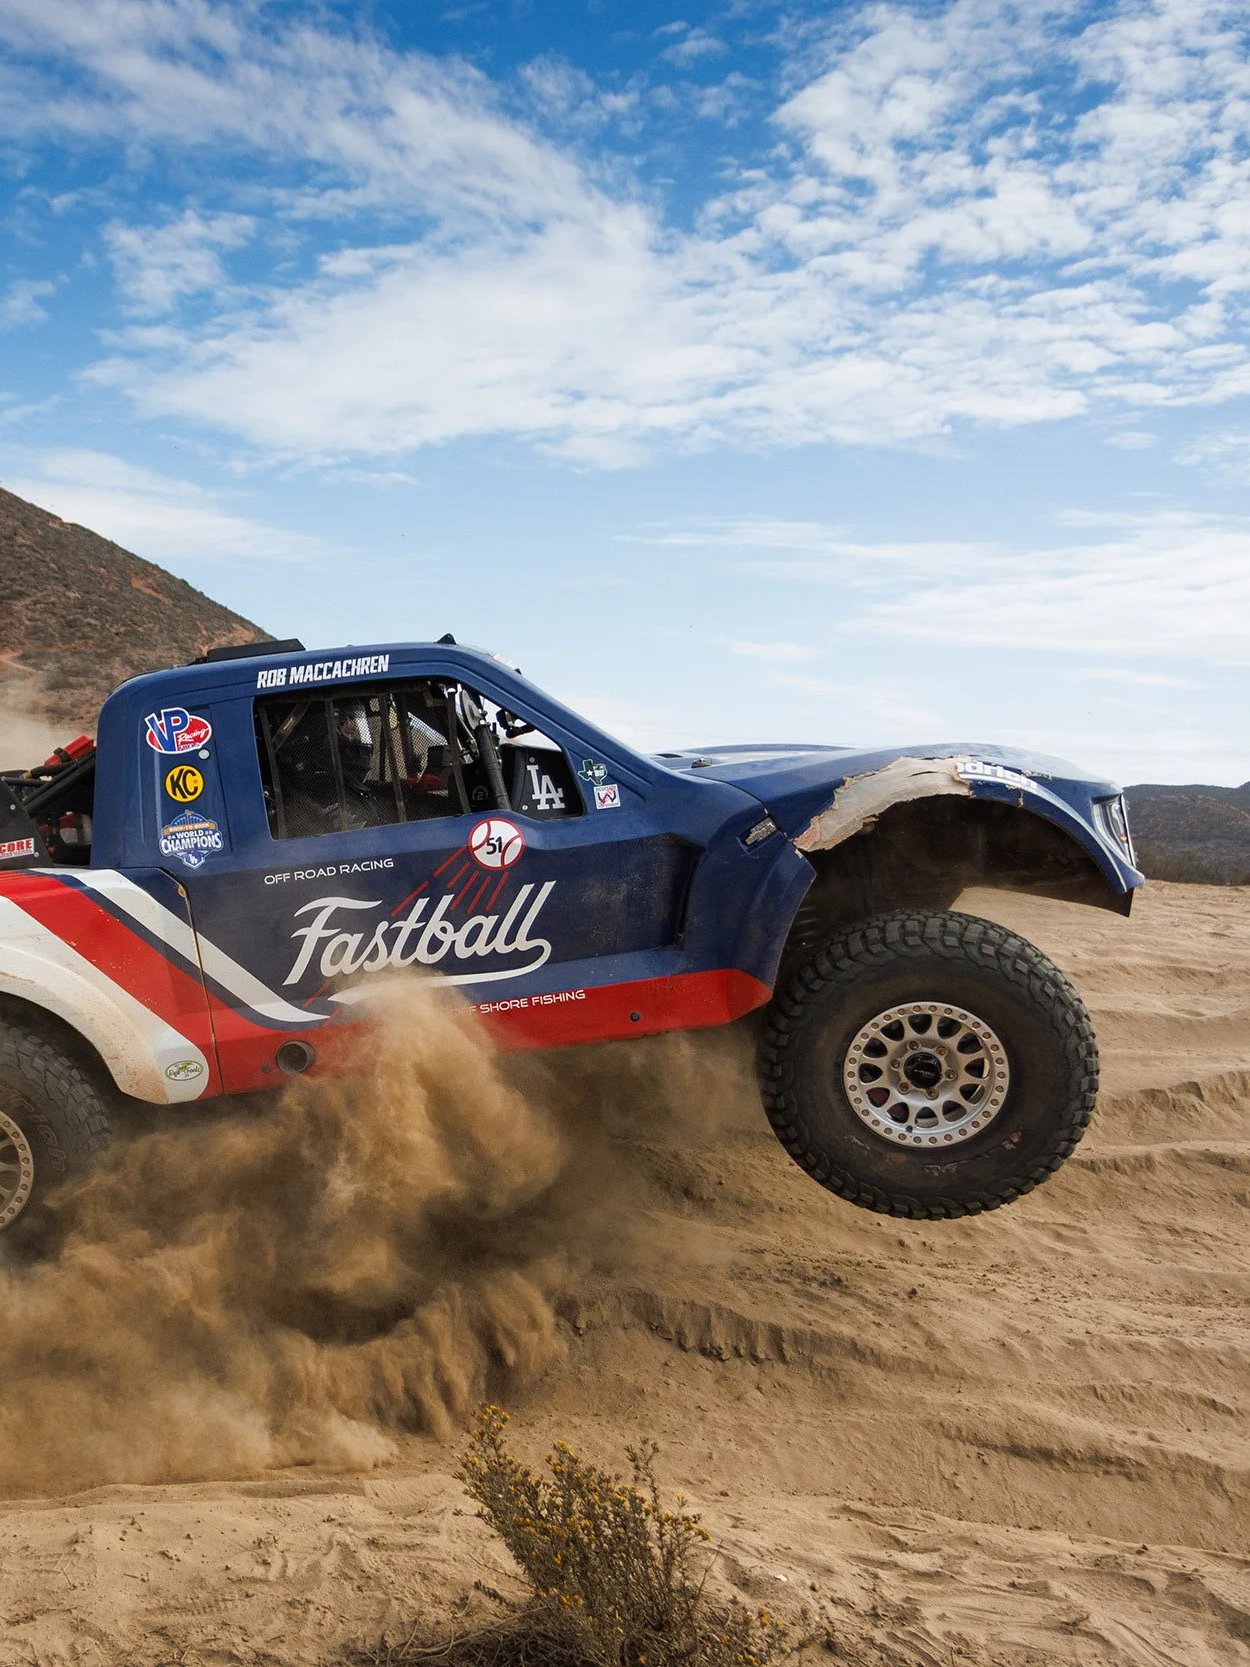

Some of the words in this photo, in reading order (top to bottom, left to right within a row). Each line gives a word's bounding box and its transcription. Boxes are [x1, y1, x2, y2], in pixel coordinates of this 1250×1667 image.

[257, 668, 287, 688] ROB
[289, 654, 390, 685] MACCACHREN
[144, 707, 190, 754] VP
[177, 728, 209, 745] Racing
[169, 768, 198, 799] KC
[527, 764, 566, 811] LA
[161, 833, 222, 853] CHAMPIONS
[176, 830, 203, 839] WORLD
[485, 835, 503, 855] 51
[264, 872, 291, 885] OFF
[294, 866, 337, 881] ROAD
[339, 858, 394, 875] RACING
[282, 881, 556, 986] Fastball
[479, 998, 529, 1014] SHORE
[531, 990, 586, 1006] FISHING
